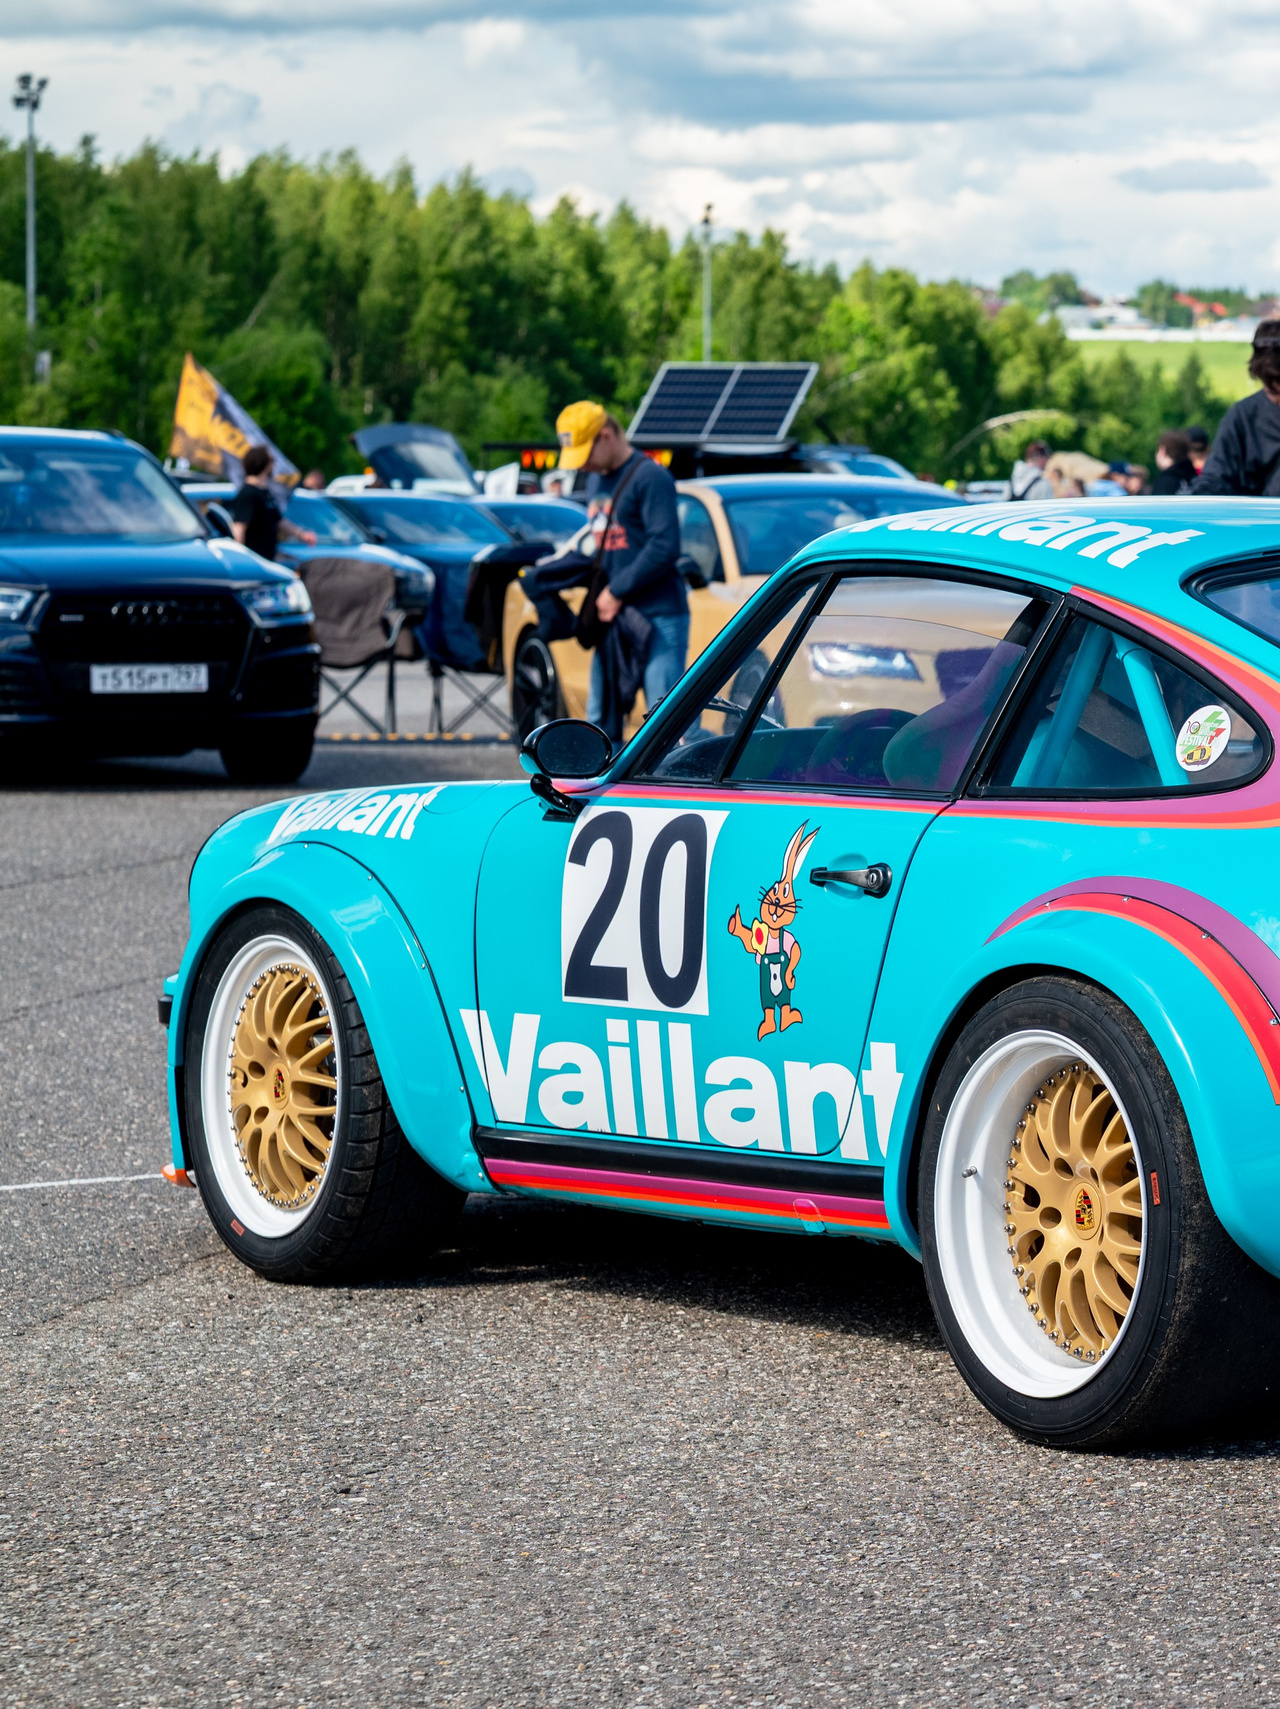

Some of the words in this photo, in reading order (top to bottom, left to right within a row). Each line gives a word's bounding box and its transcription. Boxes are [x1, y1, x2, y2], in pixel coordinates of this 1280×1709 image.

[266, 784, 448, 846] Vaillant
[563, 810, 708, 1010] 20
[459, 1008, 905, 1161] Vaillant
